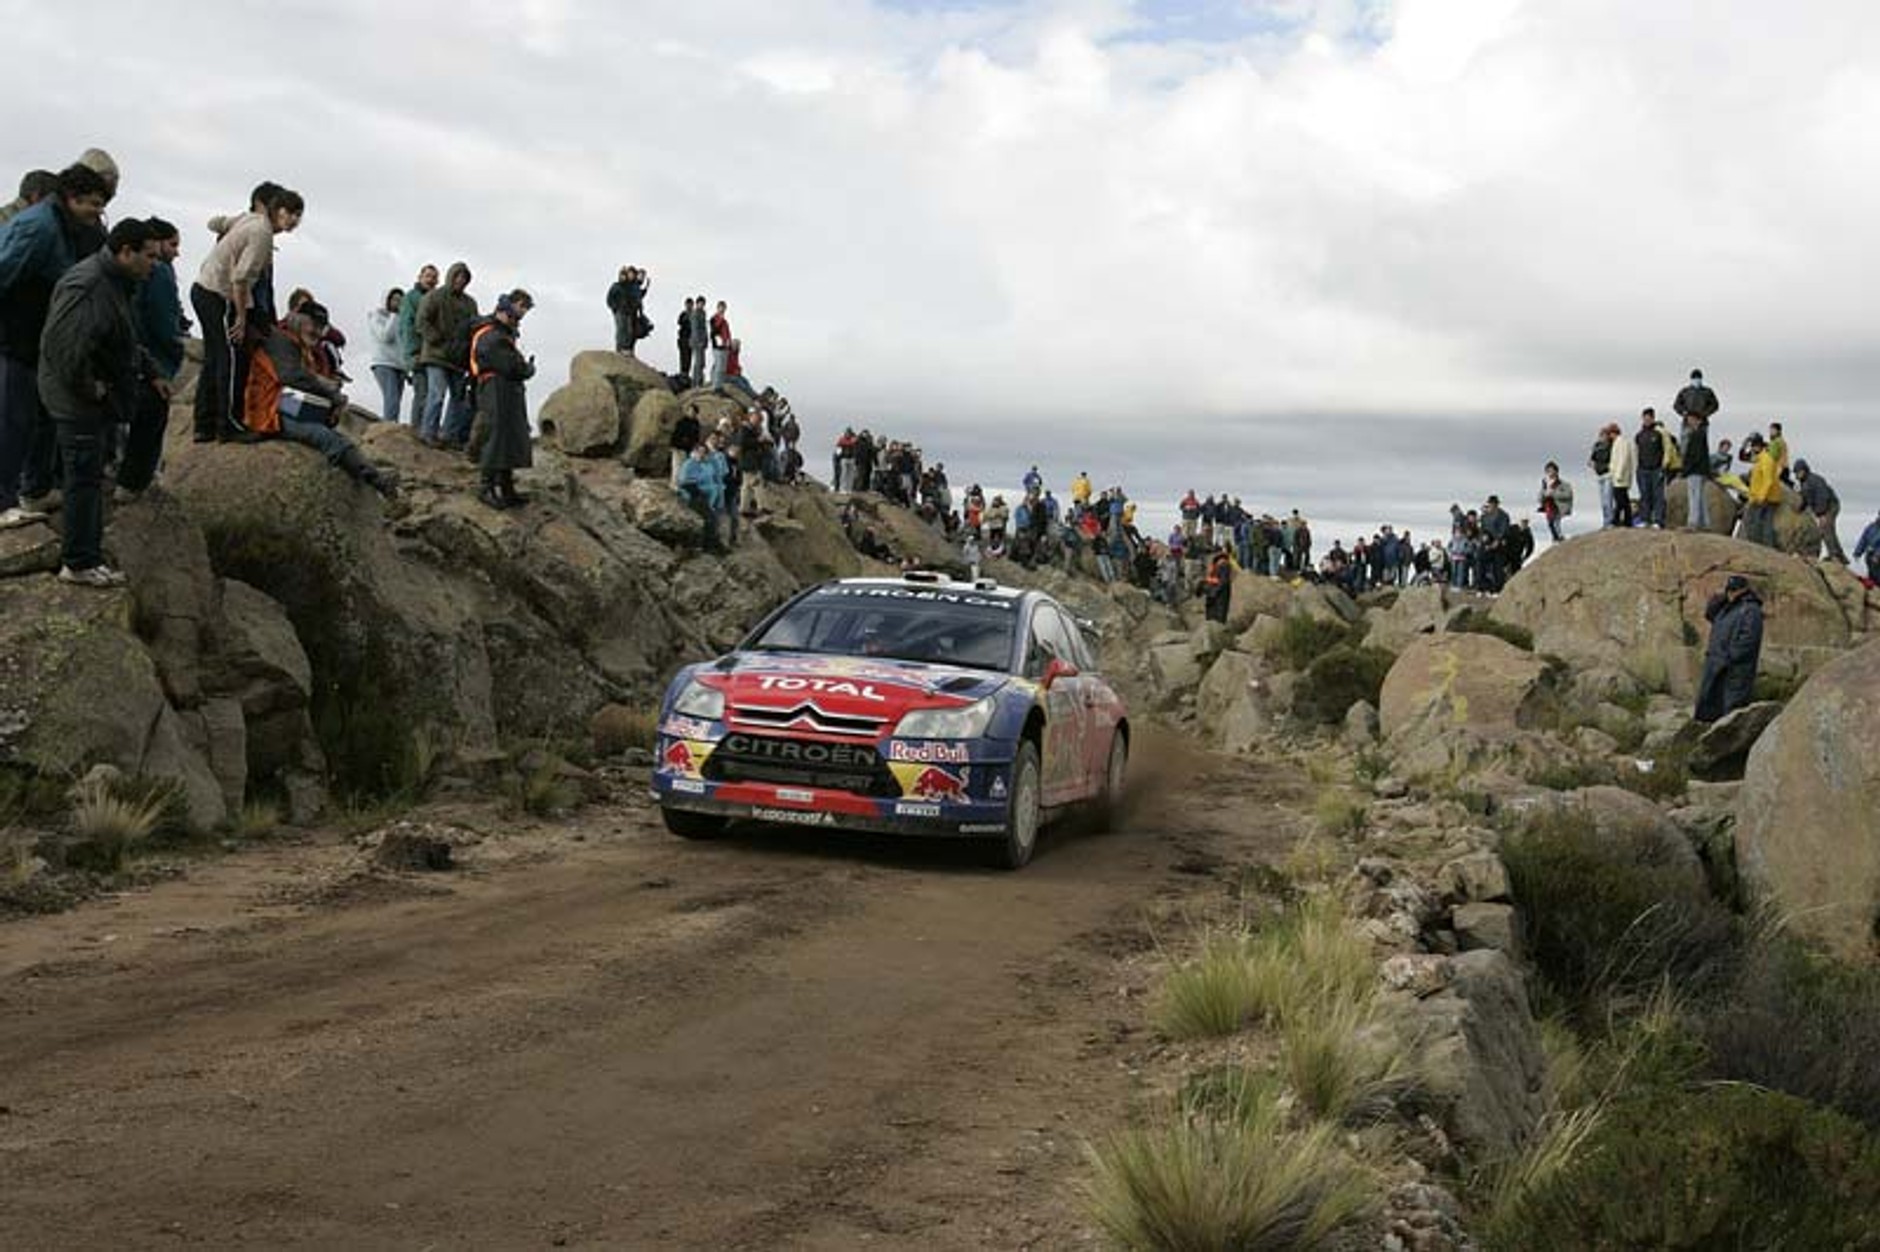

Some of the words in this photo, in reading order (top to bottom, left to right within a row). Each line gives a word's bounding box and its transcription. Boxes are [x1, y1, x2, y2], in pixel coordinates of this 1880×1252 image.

[758, 675, 885, 701] TOTAL
[726, 735, 876, 765] CITROËN
[890, 740, 932, 760] Red
[932, 742, 969, 763] Bull
